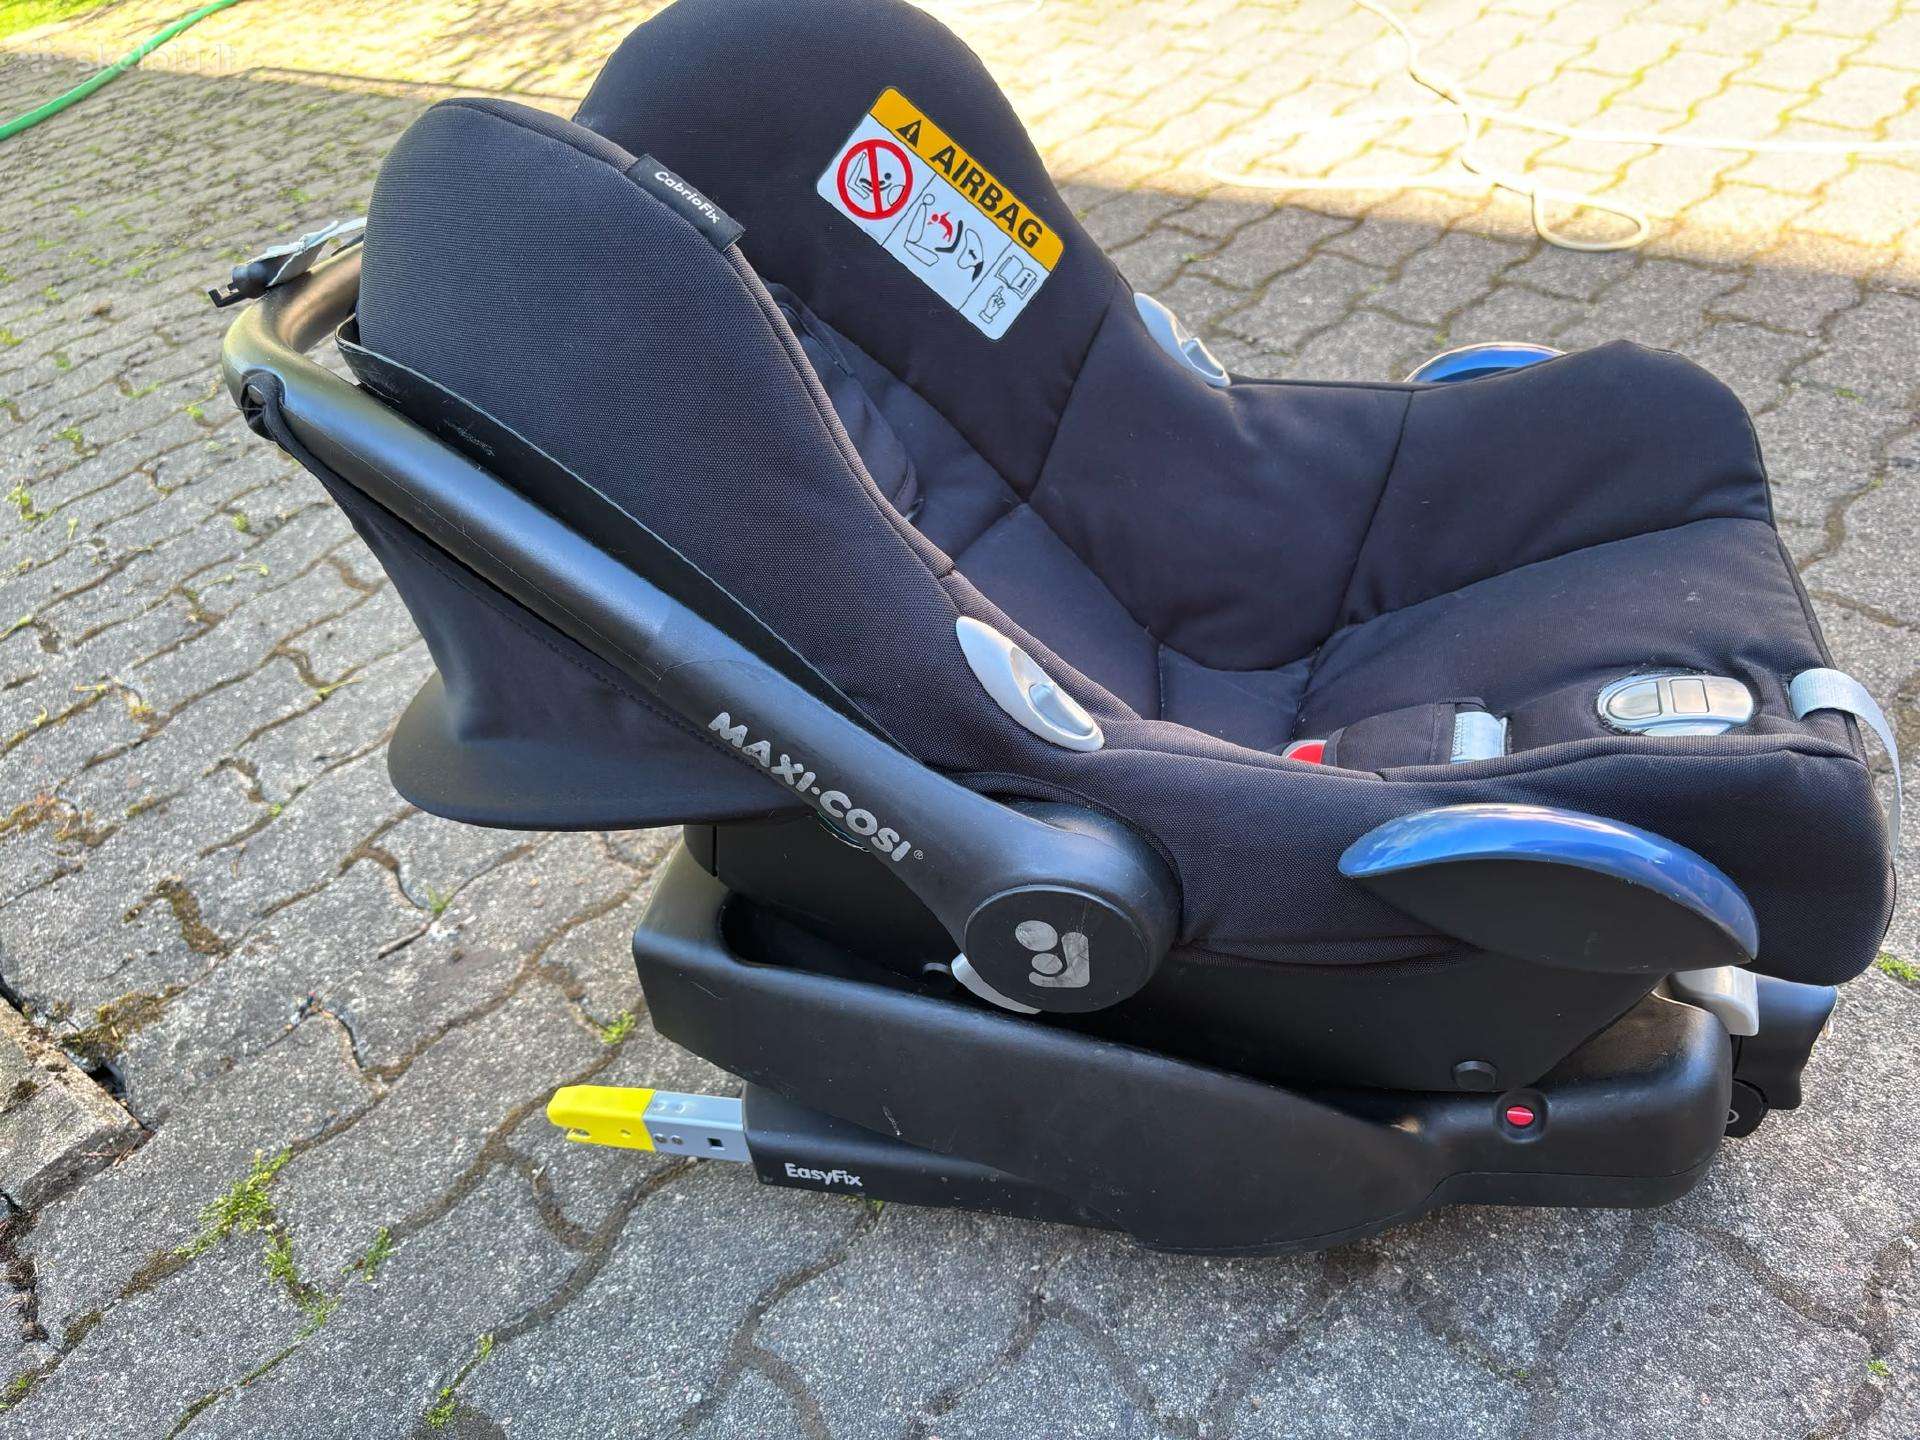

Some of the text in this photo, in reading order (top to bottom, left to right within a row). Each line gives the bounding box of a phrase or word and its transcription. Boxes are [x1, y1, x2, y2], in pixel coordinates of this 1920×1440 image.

[654, 171, 720, 223] CabrioFix
[930, 145, 1043, 248] AIRBAG
[785, 1162, 863, 1186] EasyFix
